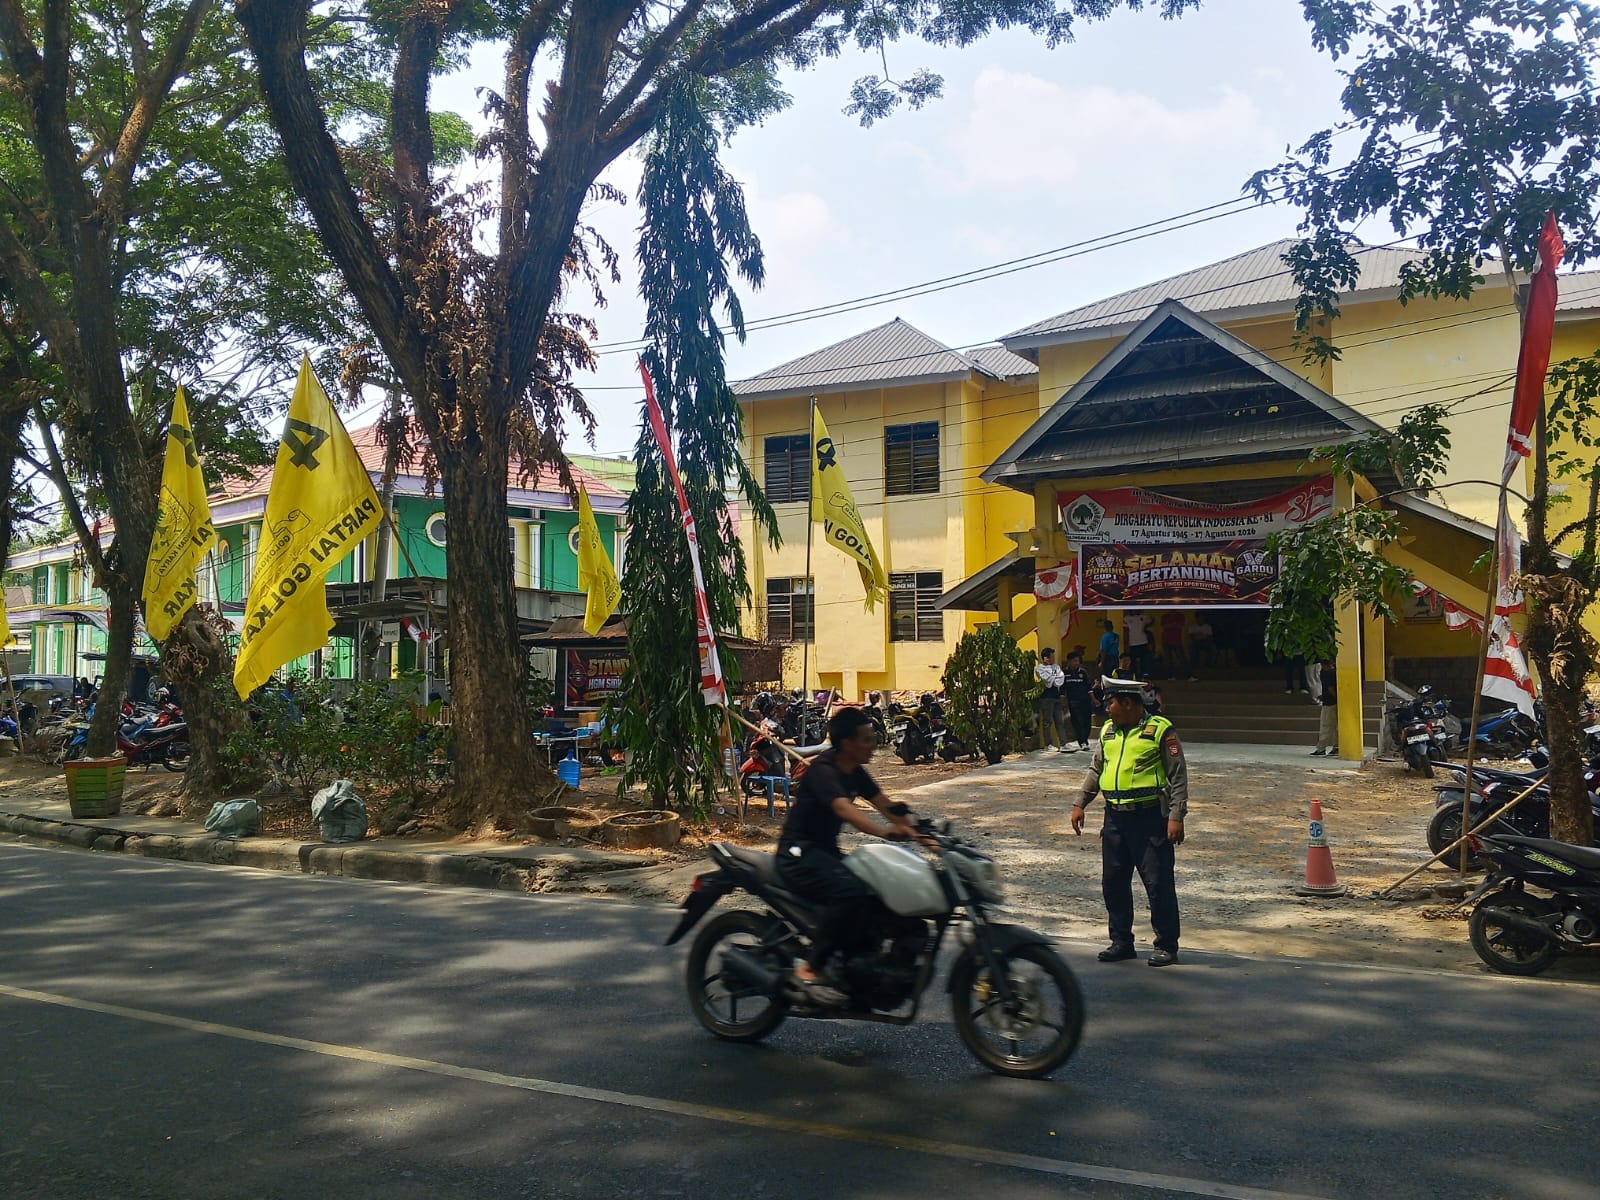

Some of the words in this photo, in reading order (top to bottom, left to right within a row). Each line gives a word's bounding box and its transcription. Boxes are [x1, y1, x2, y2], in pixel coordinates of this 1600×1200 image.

[816, 437, 837, 472] 4
[1115, 513, 1163, 527] DIRGAHAYU
[1163, 515, 1204, 528] REPUBLIK
[1204, 516, 1246, 528] INDOESIA
[1246, 514, 1260, 525] KE
[1263, 512, 1274, 523] 81
[1131, 530, 1140, 538] 17
[1140, 529, 1171, 538] Agustus
[1172, 530, 1189, 539] 1945
[1195, 531, 1203, 539] 17
[1204, 530, 1236, 539] Agustus
[1237, 528, 1257, 536] 2026
[1124, 550, 1235, 573] SELAMAT
[1085, 567, 1126, 578] DOMINO
[1127, 566, 1236, 587] BERTANDING
[1236, 565, 1274, 575] GARDU
